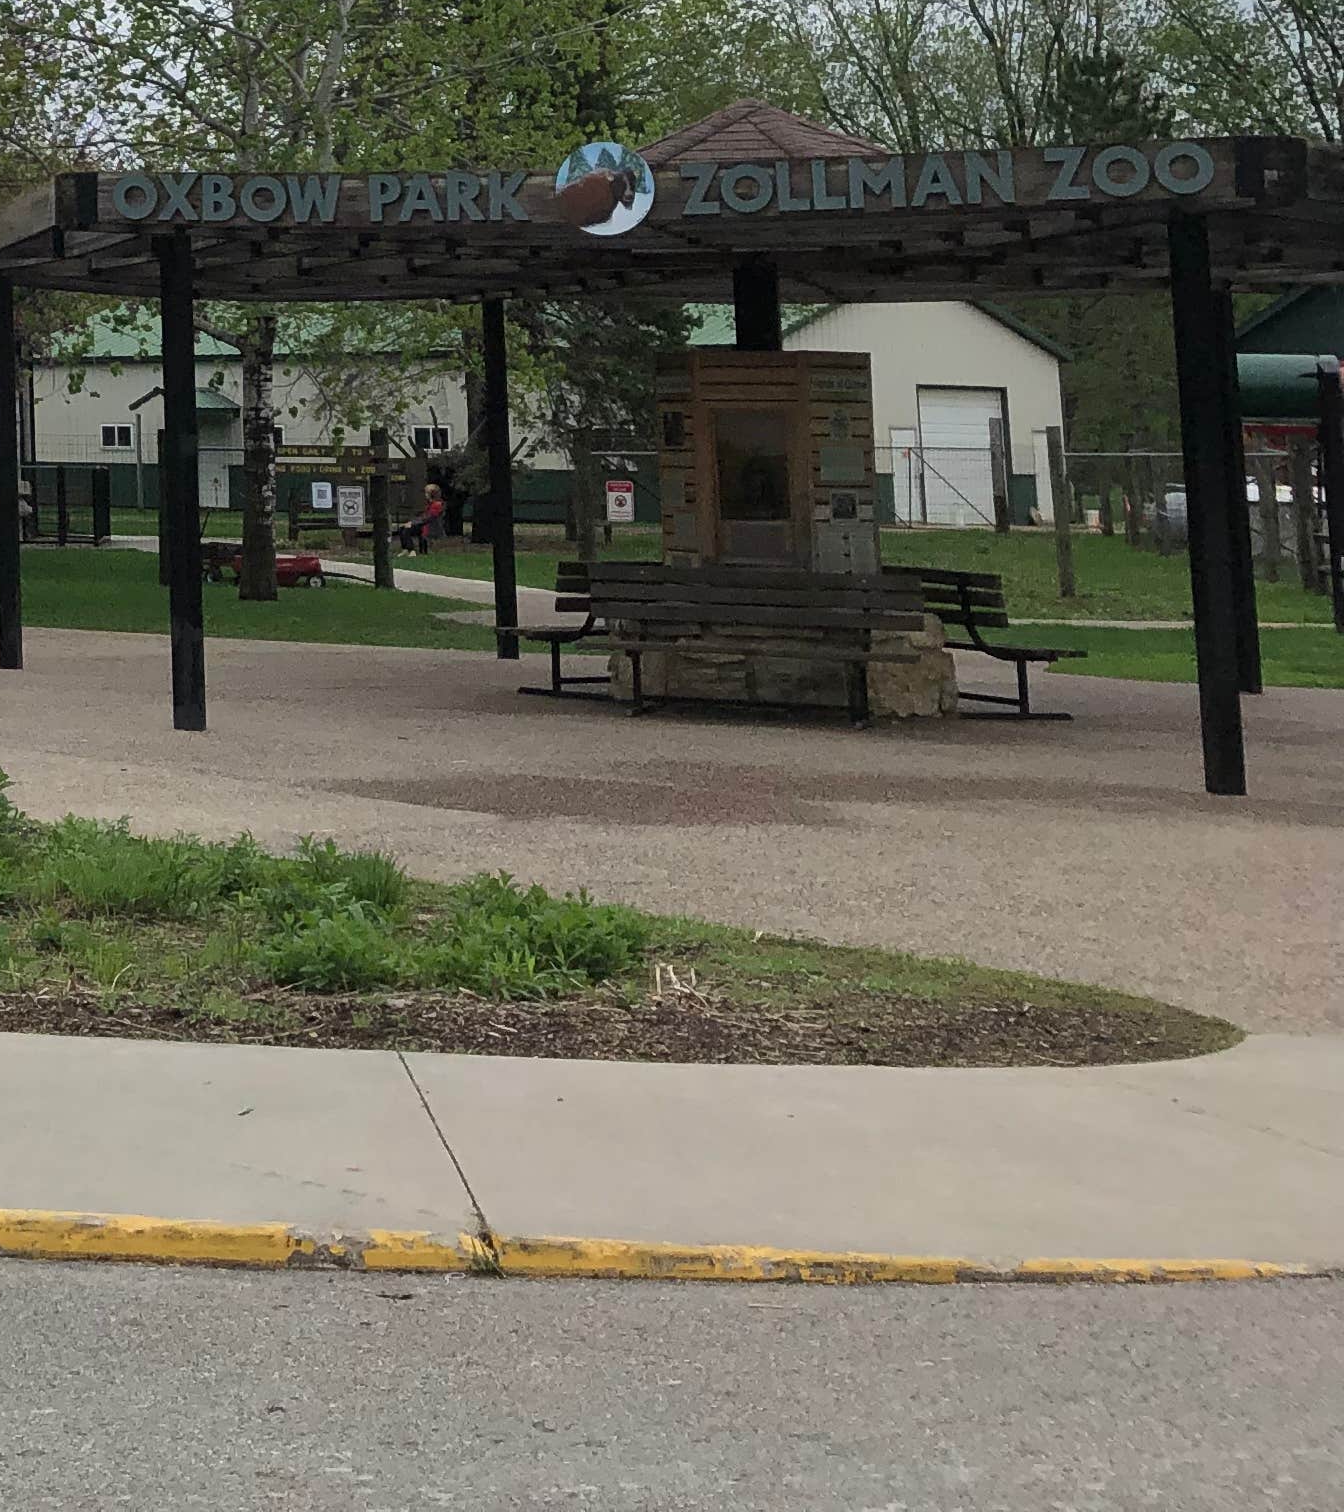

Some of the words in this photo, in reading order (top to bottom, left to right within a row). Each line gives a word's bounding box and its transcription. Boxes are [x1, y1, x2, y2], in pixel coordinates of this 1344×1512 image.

[114, 172, 341, 224] OXBOW
[368, 170, 534, 223] PARK
[679, 151, 1015, 215] ZOLLMAN
[1043, 141, 1217, 201] ZOO
